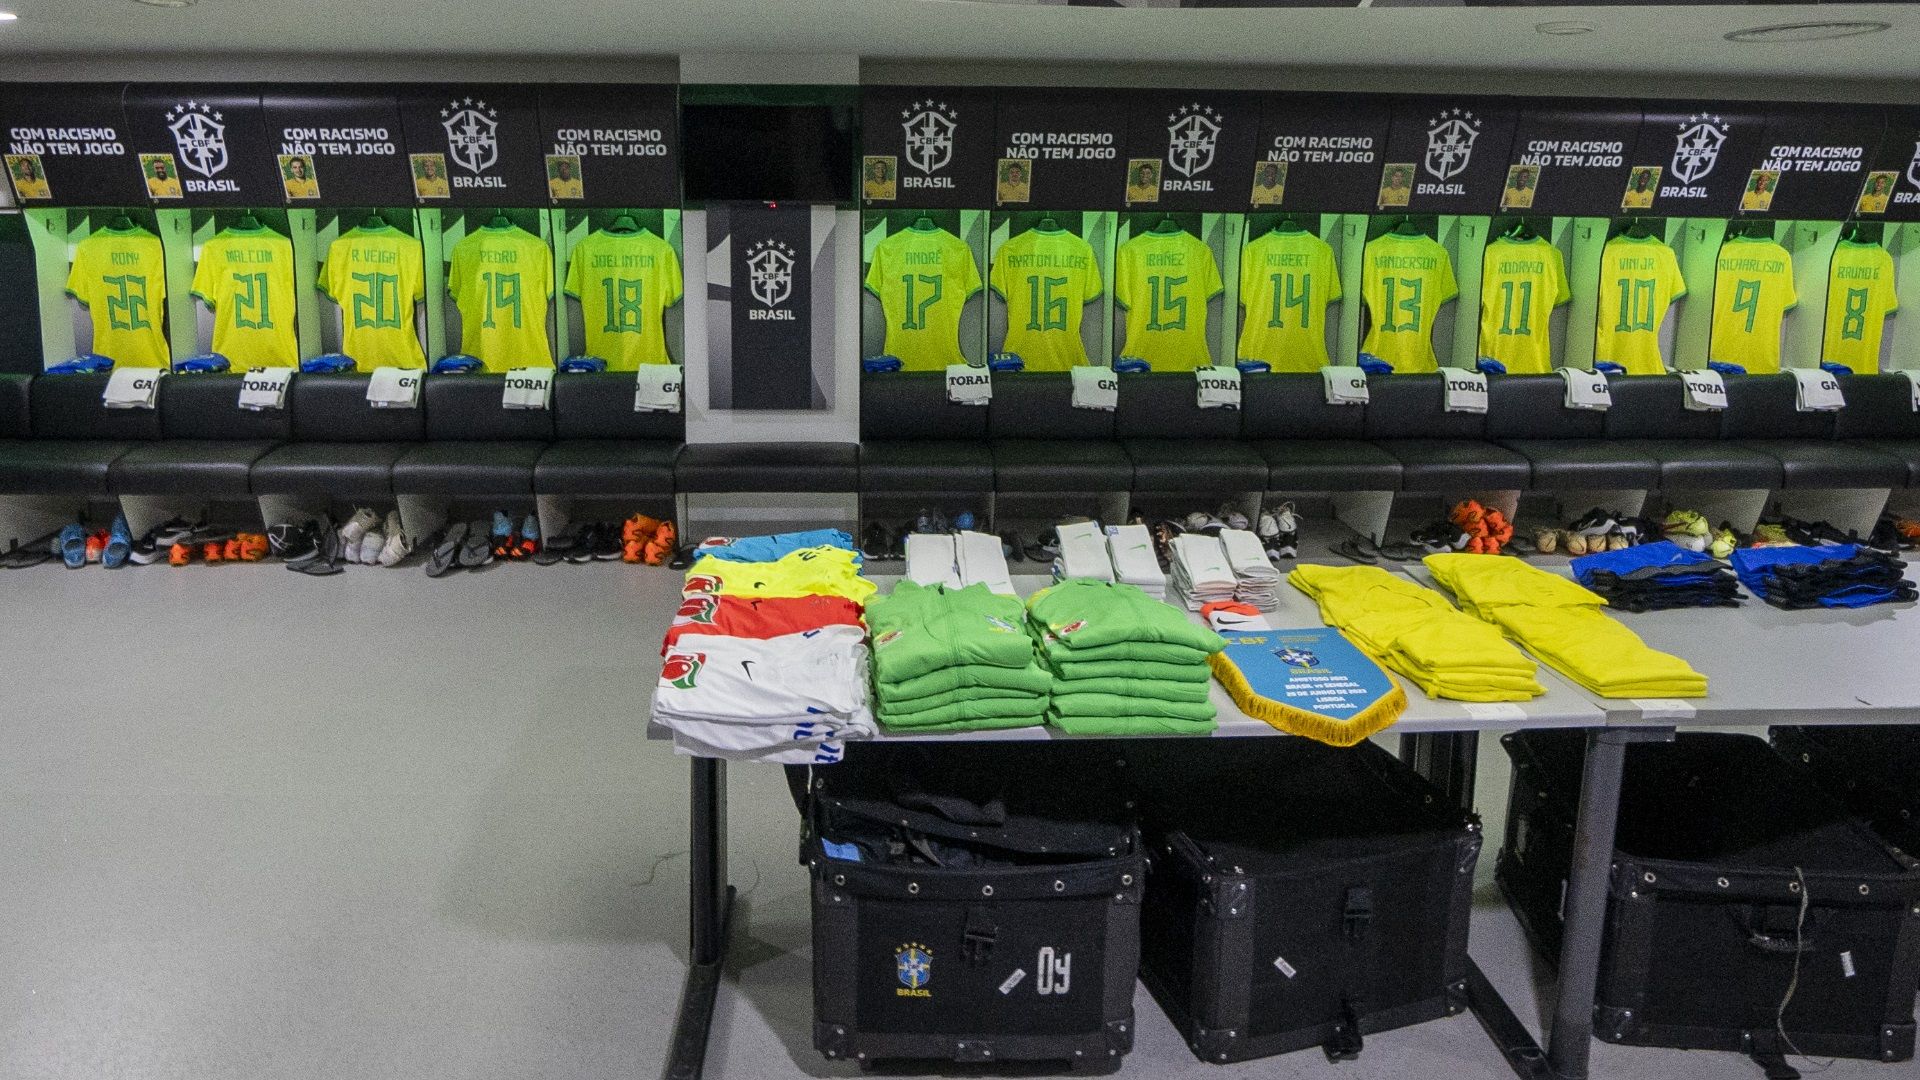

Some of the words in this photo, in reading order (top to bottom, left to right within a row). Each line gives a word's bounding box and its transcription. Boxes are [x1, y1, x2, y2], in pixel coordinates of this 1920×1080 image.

[10, 128, 44, 140] COM
[46, 128, 117, 141] RACISMO
[283, 128, 318, 140] COM
[320, 128, 389, 141] RACISMO
[463, 136, 482, 144] CBF
[557, 129, 591, 141] COM
[594, 129, 662, 142] RACISMO
[1011, 133, 1043, 145] COM
[1047, 133, 1113, 145] RACISMO
[10, 140, 45, 155] NÃO
[48, 142, 81, 155] TEM
[84, 142, 125, 155] JOGO
[191, 139, 210, 148] CBF
[282, 140, 316, 155] NÃO
[319, 142, 352, 155] TEM
[355, 142, 396, 156] JOGO
[554, 140, 586, 156] NÃO
[591, 143, 623, 156] TEM
[626, 143, 667, 156] JOGO
[919, 138, 938, 146] CBF
[1183, 141, 1201, 149] CBF
[1274, 136, 1305, 149] COM
[1308, 137, 1373, 149] RACISMO
[1528, 140, 1559, 153] COM
[1561, 141, 1623, 154] RACISMO
[1006, 144, 1038, 159] NÃO
[1044, 147, 1074, 159] TEM
[1077, 147, 1116, 160] JOGO
[1267, 148, 1299, 163] NÃO
[1303, 151, 1335, 163] TEM
[1336, 151, 1374, 163] JOGO
[1687, 148, 1705, 156] CBF
[1770, 145, 1800, 158] COM
[1801, 146, 1863, 159] RACISMO
[1520, 151, 1552, 167] NÃO
[1555, 155, 1586, 167] TEM
[1586, 155, 1623, 168] JOGO
[1761, 156, 1793, 172] NÃO
[1795, 160, 1825, 172] TEM
[1825, 160, 1862, 172] JOGO
[186, 179, 240, 192] BRASIL
[453, 175, 506, 188] BRASIL
[903, 177, 955, 189] BRASIL
[1163, 180, 1214, 192] BRASIL
[1416, 183, 1466, 196] BRASIL
[1660, 186, 1708, 198] BRASIL
[1894, 192, 1920, 204] BRA
[111, 251, 140, 265] RONY
[226, 249, 273, 264] MALCOM
[364, 250, 396, 264] VEIGA
[480, 251, 517, 264] PEDRO
[591, 254, 655, 268] JOELINTON
[1008, 254, 1051, 268] AYRTON
[1053, 255, 1089, 270] LUCAS
[1267, 253, 1310, 267] ROBERT
[1374, 256, 1437, 270] VANDERSON
[1619, 258, 1639, 270] VINI
[1719, 258, 1785, 274] RICHARLISON
[763, 273, 779, 281] CBF
[1838, 266, 1871, 280] BRUNO
[103, 275, 151, 331] 22
[233, 273, 274, 329] 21
[352, 272, 401, 329] 20
[483, 272, 521, 329] 19
[602, 277, 642, 334] 18
[902, 274, 943, 330] 17
[1026, 275, 1068, 331] 16
[1146, 275, 1188, 331] 15
[1268, 273, 1311, 329] 14
[1380, 277, 1423, 332] 13
[1615, 278, 1656, 333] 10
[1732, 279, 1761, 333] 9
[749, 309, 795, 321] BRASIL
[1499, 281, 1532, 336] 11
[1841, 288, 1868, 341] 8
[133, 379, 156, 390] GA
[1200, 379, 1241, 390] TORA
[1448, 381, 1488, 392] TORA
[1688, 383, 1726, 394] TORA
[896, 988, 932, 998] BRASIL
